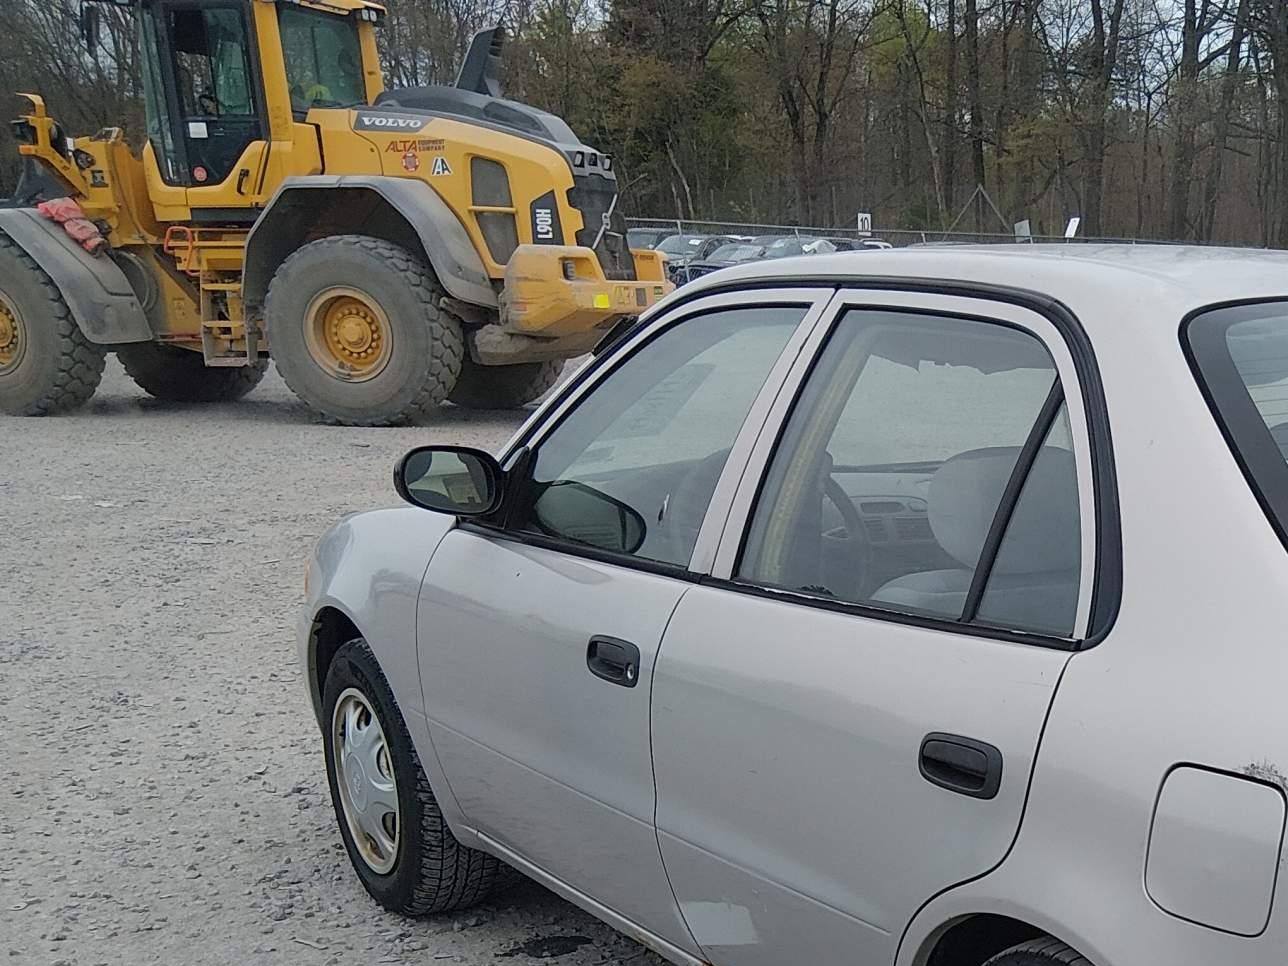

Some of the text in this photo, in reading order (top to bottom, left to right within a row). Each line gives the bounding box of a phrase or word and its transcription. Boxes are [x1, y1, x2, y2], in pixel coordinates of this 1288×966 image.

[362, 117, 421, 128] VOLVO
[385, 140, 417, 152] ALTA
[536, 208, 553, 239] L90H
[860, 215, 870, 232] 10
